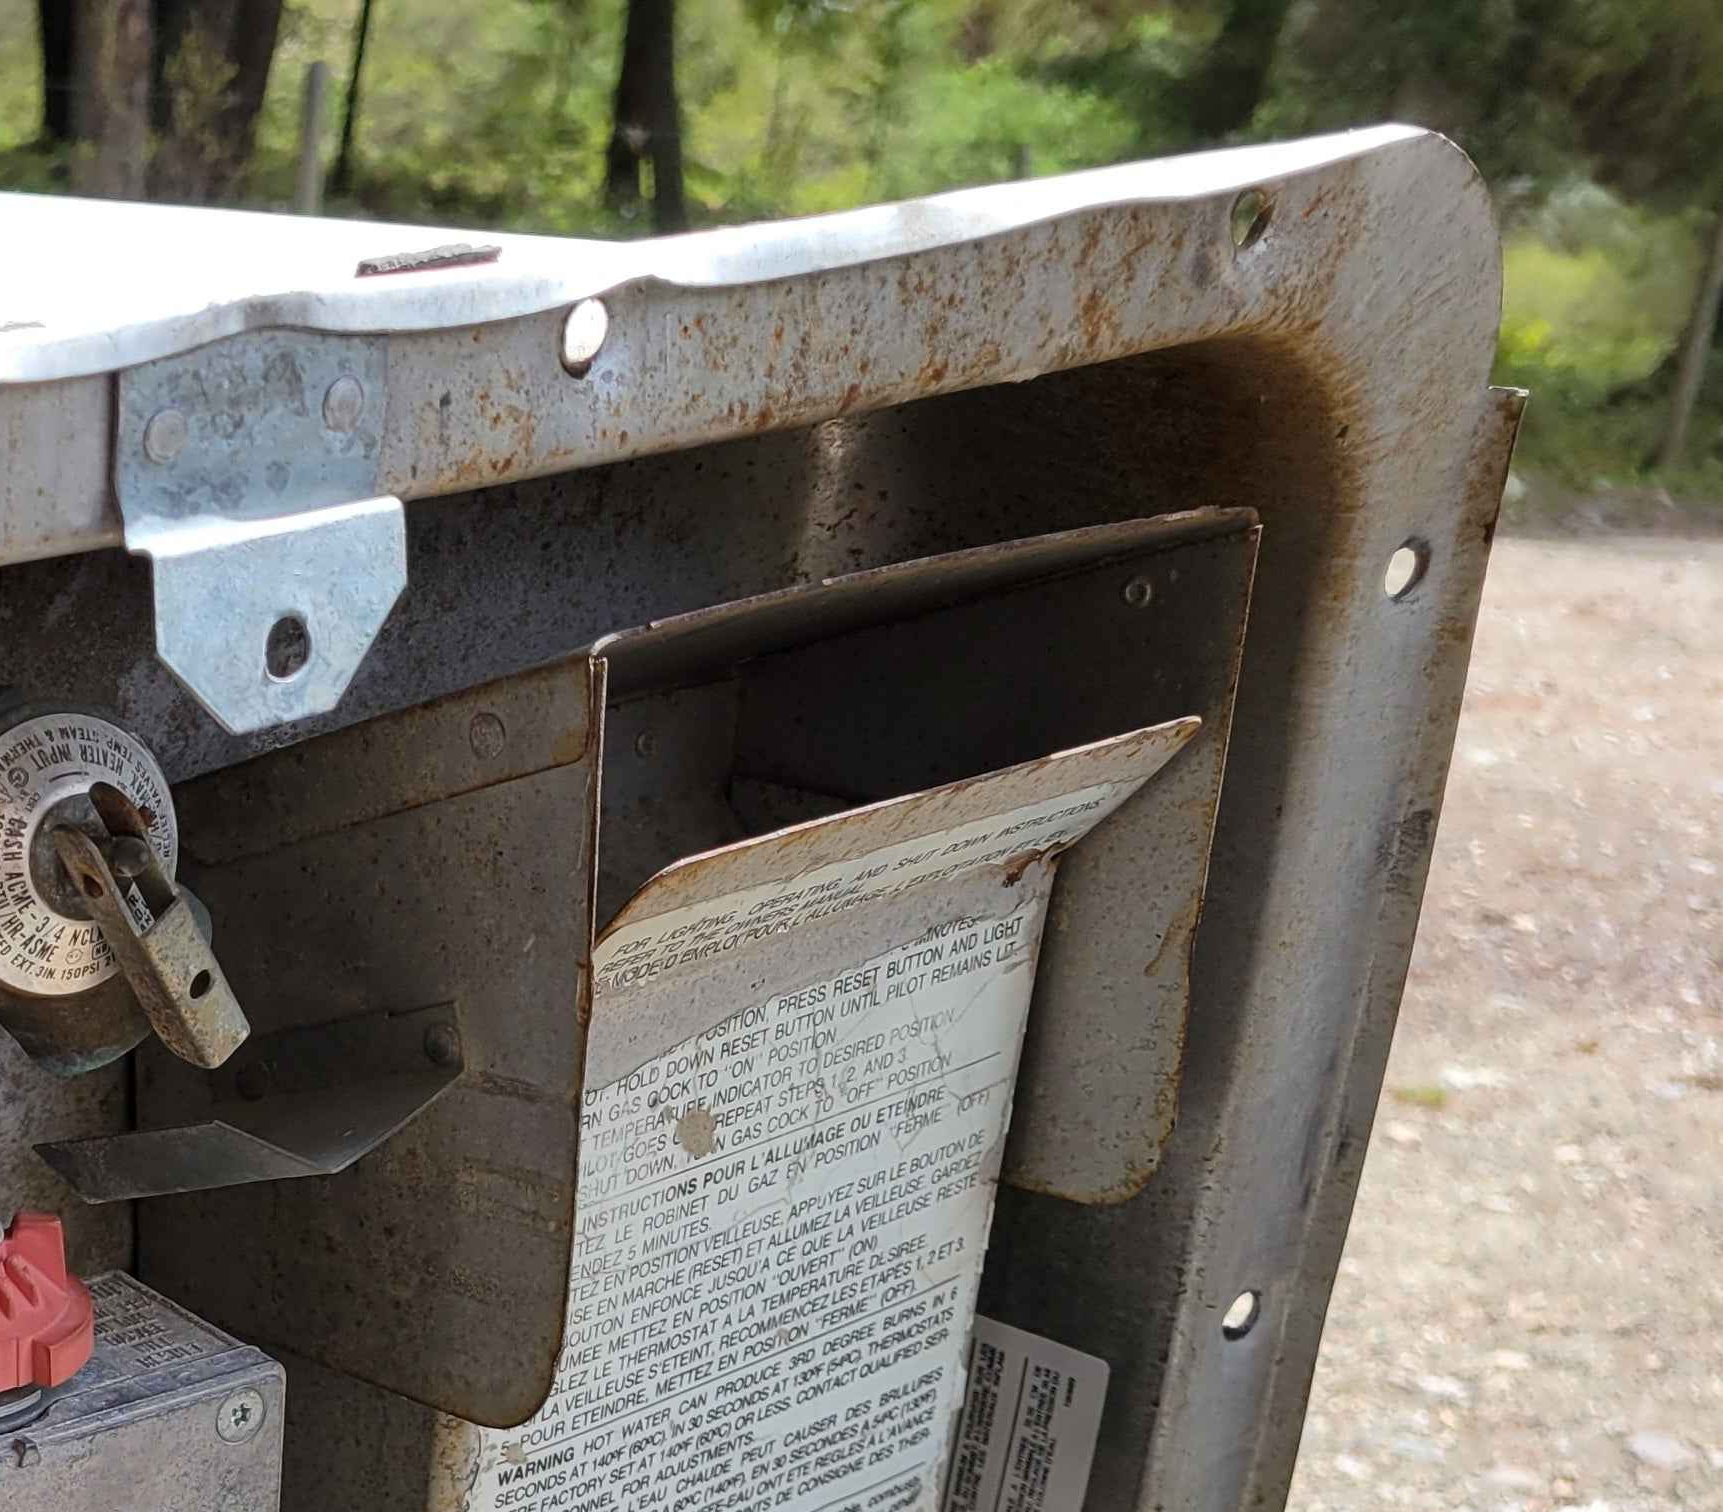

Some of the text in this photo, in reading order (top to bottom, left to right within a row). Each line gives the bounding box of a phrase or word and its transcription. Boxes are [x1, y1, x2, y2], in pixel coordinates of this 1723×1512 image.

[29, 743, 72, 772] INPUT
[44, 730, 56, 743] &
[78, 743, 124, 777] HEATER
[135, 759, 162, 808] VALVES
[3, 817, 27, 861] CASH
[5, 871, 36, 916] ACME
[613, 936, 650, 958] FOR
[850, 862, 889, 885] AND
[891, 844, 942, 872] SHUT
[938, 829, 994, 858] DOWN
[10, 953, 34, 976] EXT.
[60, 961, 100, 981] 150PSI
[598, 947, 656, 976] REFER
[662, 940, 684, 955] TO
[688, 927, 723, 947] THE
[777, 916, 1023, 1016] PRESS RESET BUTTON AND LIGHT
[616, 949, 992, 1095] HOLD DOWN RESET BUTTON UNTIL PILOT REMAINS
[623, 1050, 895, 1163] GOES AND
[695, 1067, 719, 1091] TO
[712, 1032, 886, 1108] INDICATOR TO DESIRED
[702, 1112, 871, 1189] POUR OU
[730, 1095, 834, 1146] GAS COCK TO
[602, 1136, 966, 1292] EN POSITION SUR LE BOUTON
[614, 1129, 881, 1243] LE ROBINET DU GAZ EN POSITION
[596, 1201, 852, 1317] EN MARCHE ET ALLUMEZ LA
[630, 1172, 978, 1325] ENFONCE CE QUE LA VEILLEUSE RESTE
[541, 1279, 858, 1422] LA VEILLEUSE RECOMMENCEZ LES
[593, 1258, 865, 1381] LE THERMOSTAT LA TEMPERATURE
[608, 1277, 767, 1354] METTEZ EN POSITION
[496, 1300, 927, 1490] WARNING HOT WATER CAN PRODUCE 3RD DEGREE BURNS
[519, 1349, 738, 1451] POUR METTEZ EN
[493, 1375, 789, 1511] SECONDS AT IN SECONDS AT
[540, 1471, 606, 1512] FACTORY
[608, 1459, 636, 1484] SET
[637, 1450, 656, 1471] AT
[734, 1409, 756, 1431] OR
[795, 1366, 857, 1405] CONTACT
[675, 1456, 732, 1493] CHAUDE
[740, 1438, 775, 1465] PEUT
[782, 1411, 838, 1447] CAUSER
[844, 1396, 872, 1420] DES
[620, 1473, 650, 1498] FOR
